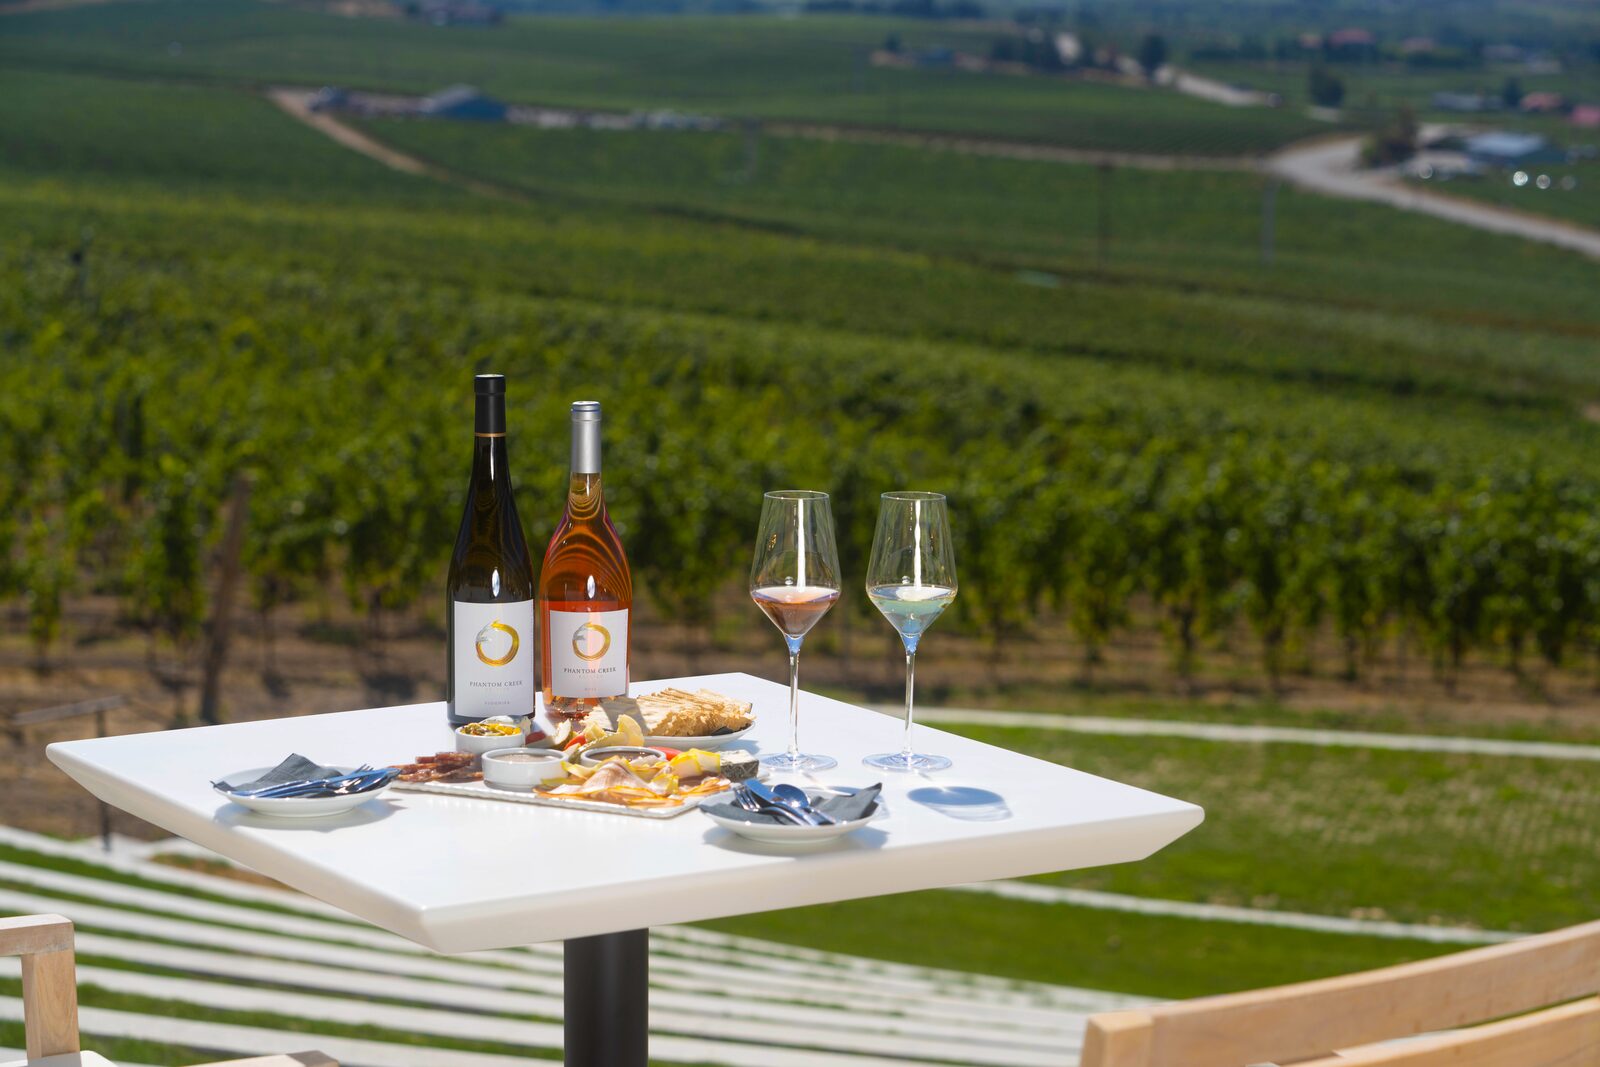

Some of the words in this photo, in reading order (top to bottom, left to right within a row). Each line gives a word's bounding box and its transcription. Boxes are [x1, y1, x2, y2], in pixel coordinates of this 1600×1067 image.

[598, 666, 617, 674] CREEK
[469, 680, 502, 688] PHANTOM
[504, 679, 523, 687] CREEK
